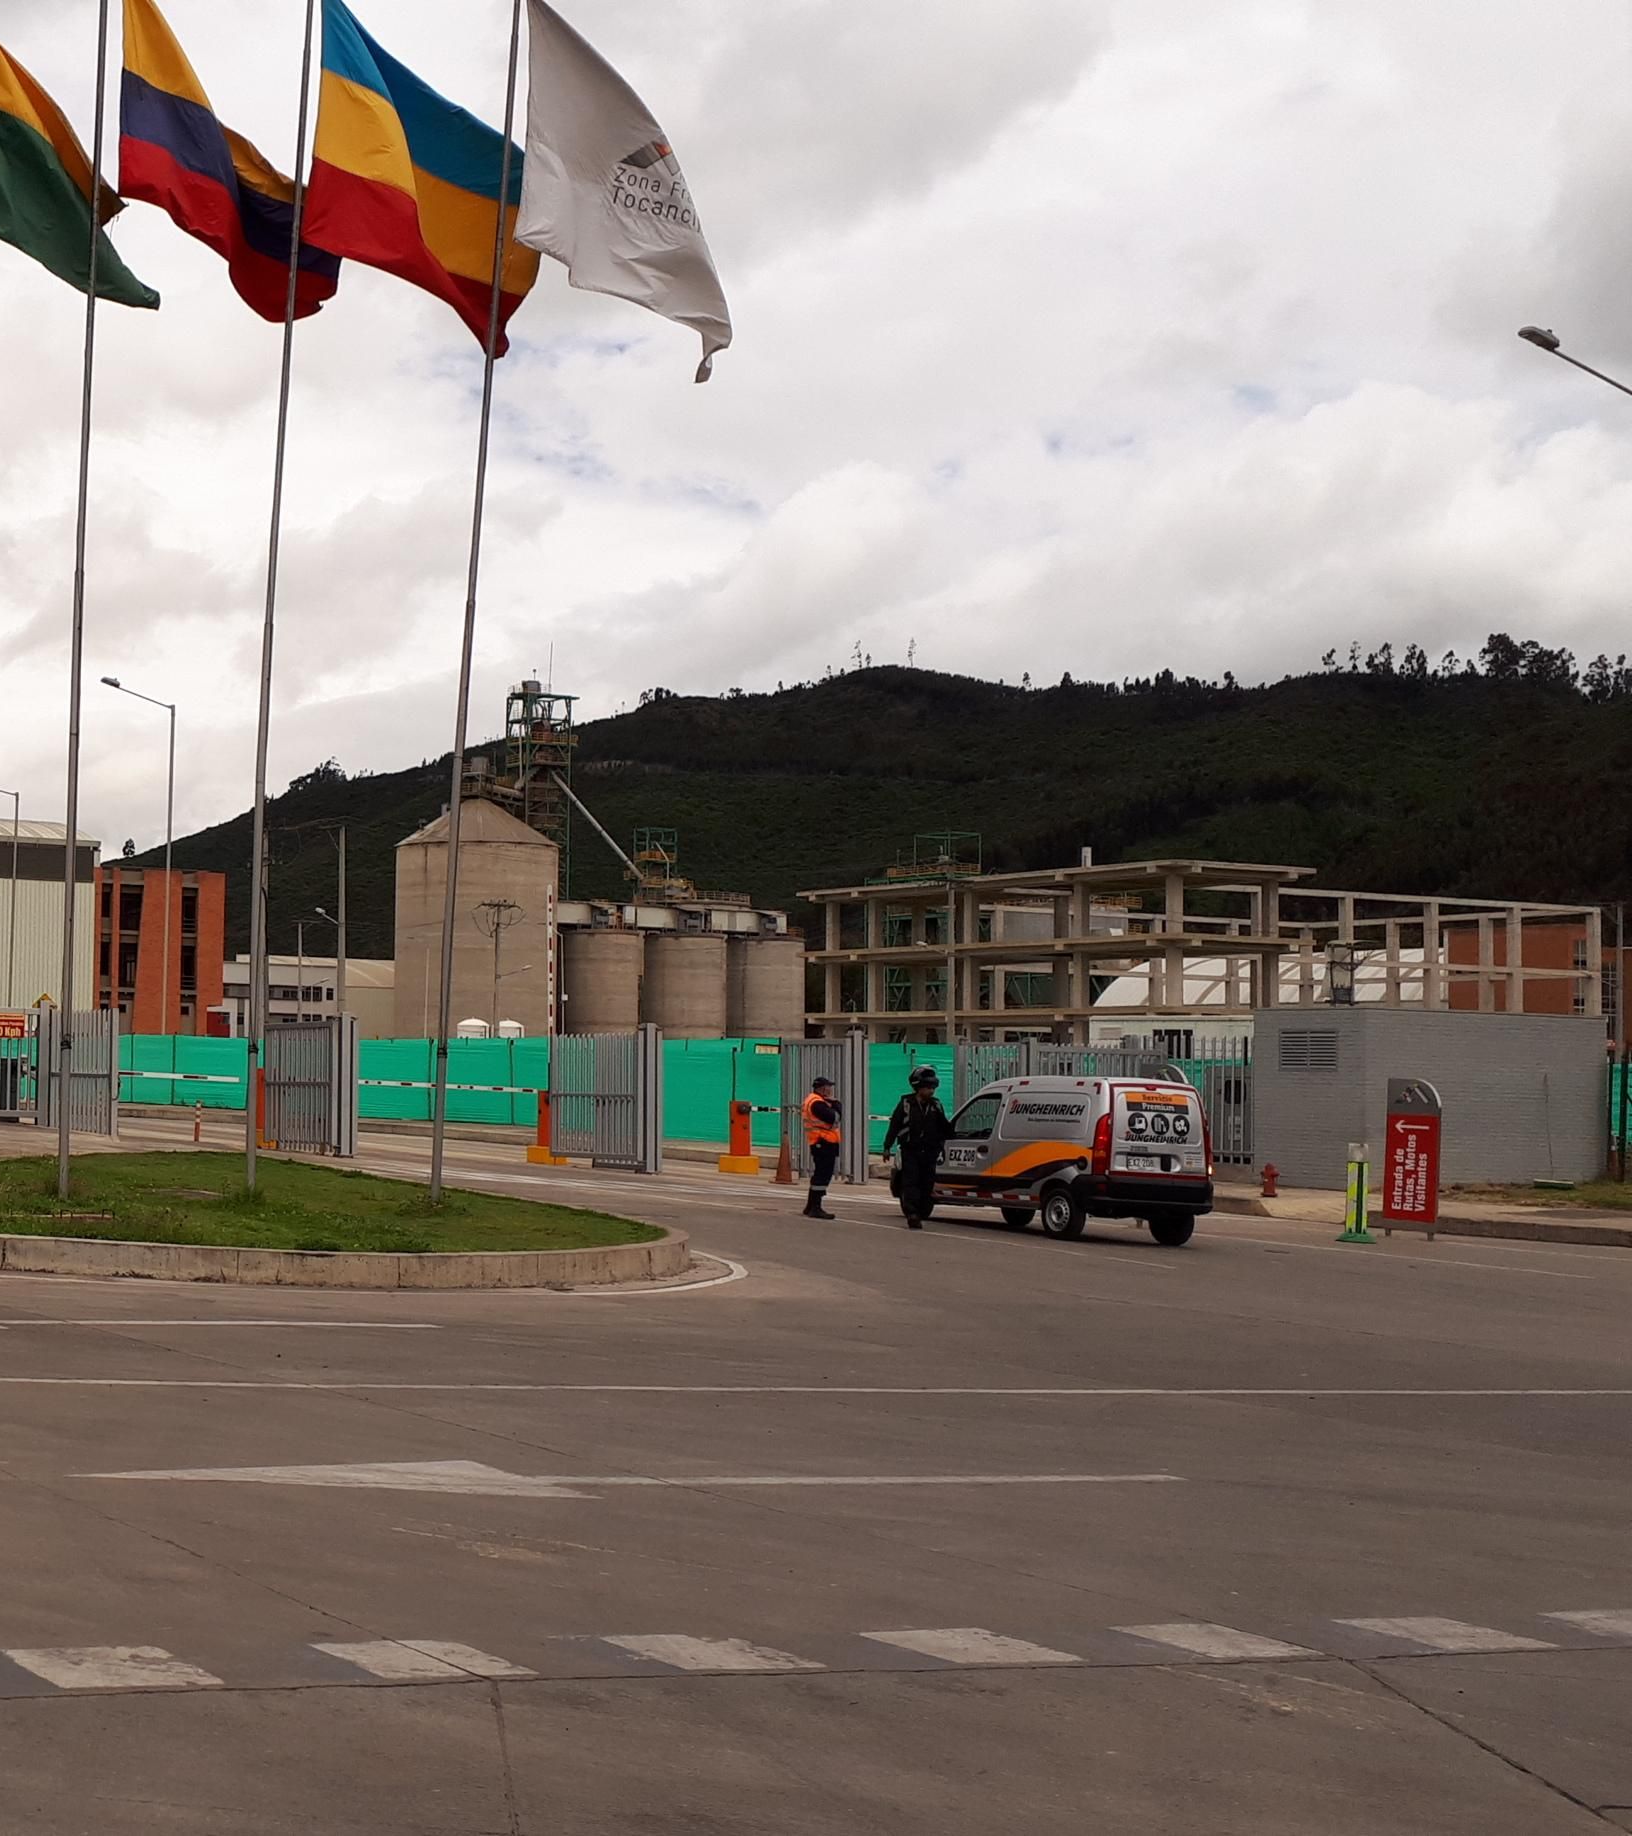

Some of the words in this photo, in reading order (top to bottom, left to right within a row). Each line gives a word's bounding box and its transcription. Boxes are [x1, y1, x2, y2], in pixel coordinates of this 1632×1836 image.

[614, 166, 661, 193] Zona
[4, 1026, 21, 1037] Kph
[1009, 1099, 1085, 1116] JUNGHEINRICH
[1142, 1103, 1175, 1112] Premium
[1125, 1131, 1188, 1144] JUNGHEINRICH
[1394, 1148, 1405, 1163] de
[1405, 1134, 1417, 1171] Motos
[1392, 1165, 1404, 1210] Entrada
[1403, 1173, 1416, 1211] Rutas,
[1415, 1153, 1428, 1212] Visitantes
